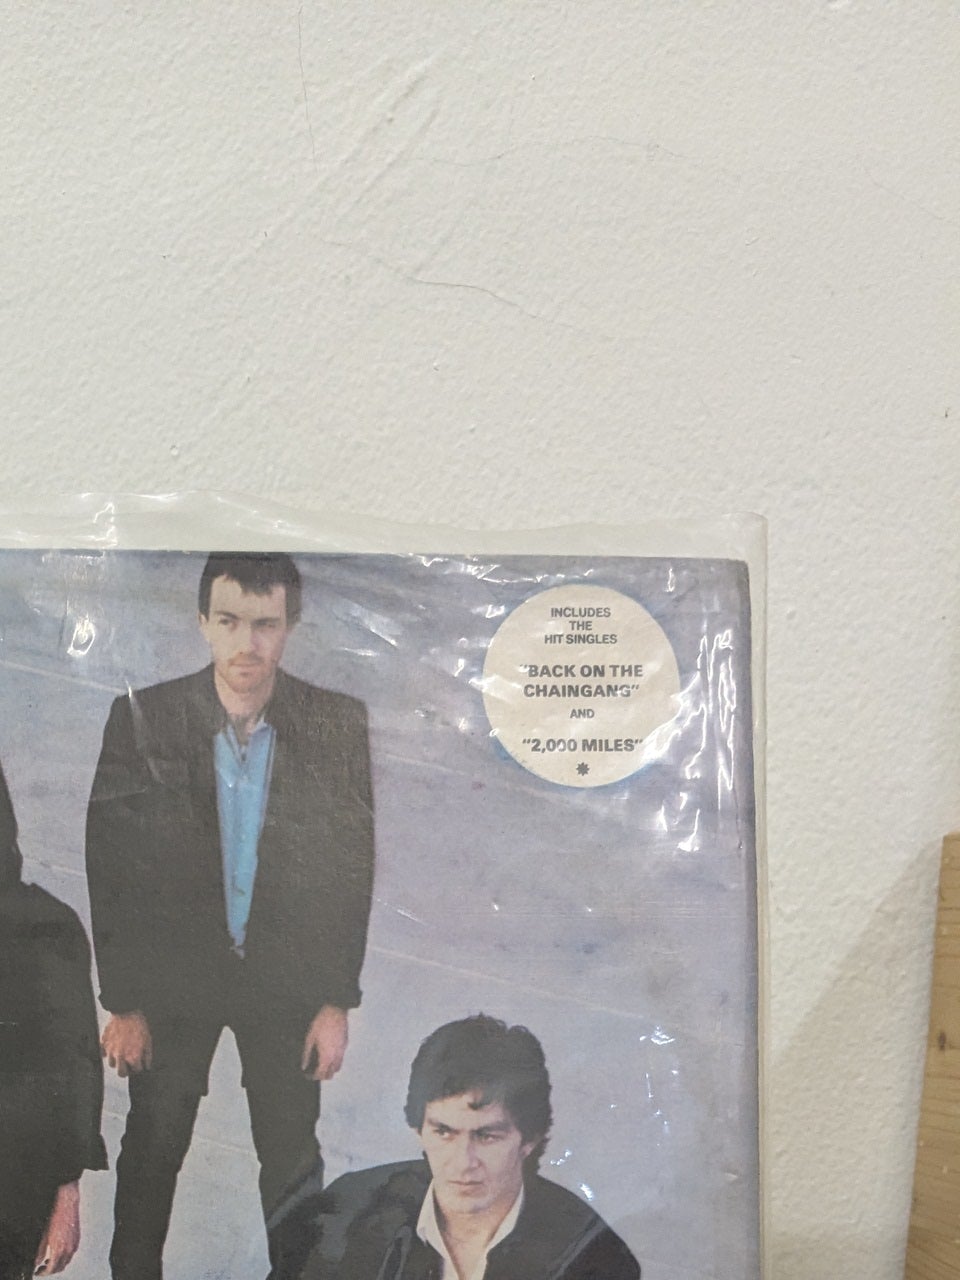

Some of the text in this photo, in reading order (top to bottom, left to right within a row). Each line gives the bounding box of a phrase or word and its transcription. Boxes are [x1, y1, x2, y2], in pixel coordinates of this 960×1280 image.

[550, 607, 611, 618] INCLUDES
[569, 620, 592, 631] THE
[544, 634, 618, 645] HIT SINGLES
[580, 664, 605, 678] ON
[609, 664, 643, 678] THE
[570, 708, 595, 719] AND
[522, 738, 644, 754] "2,000 MILES"
